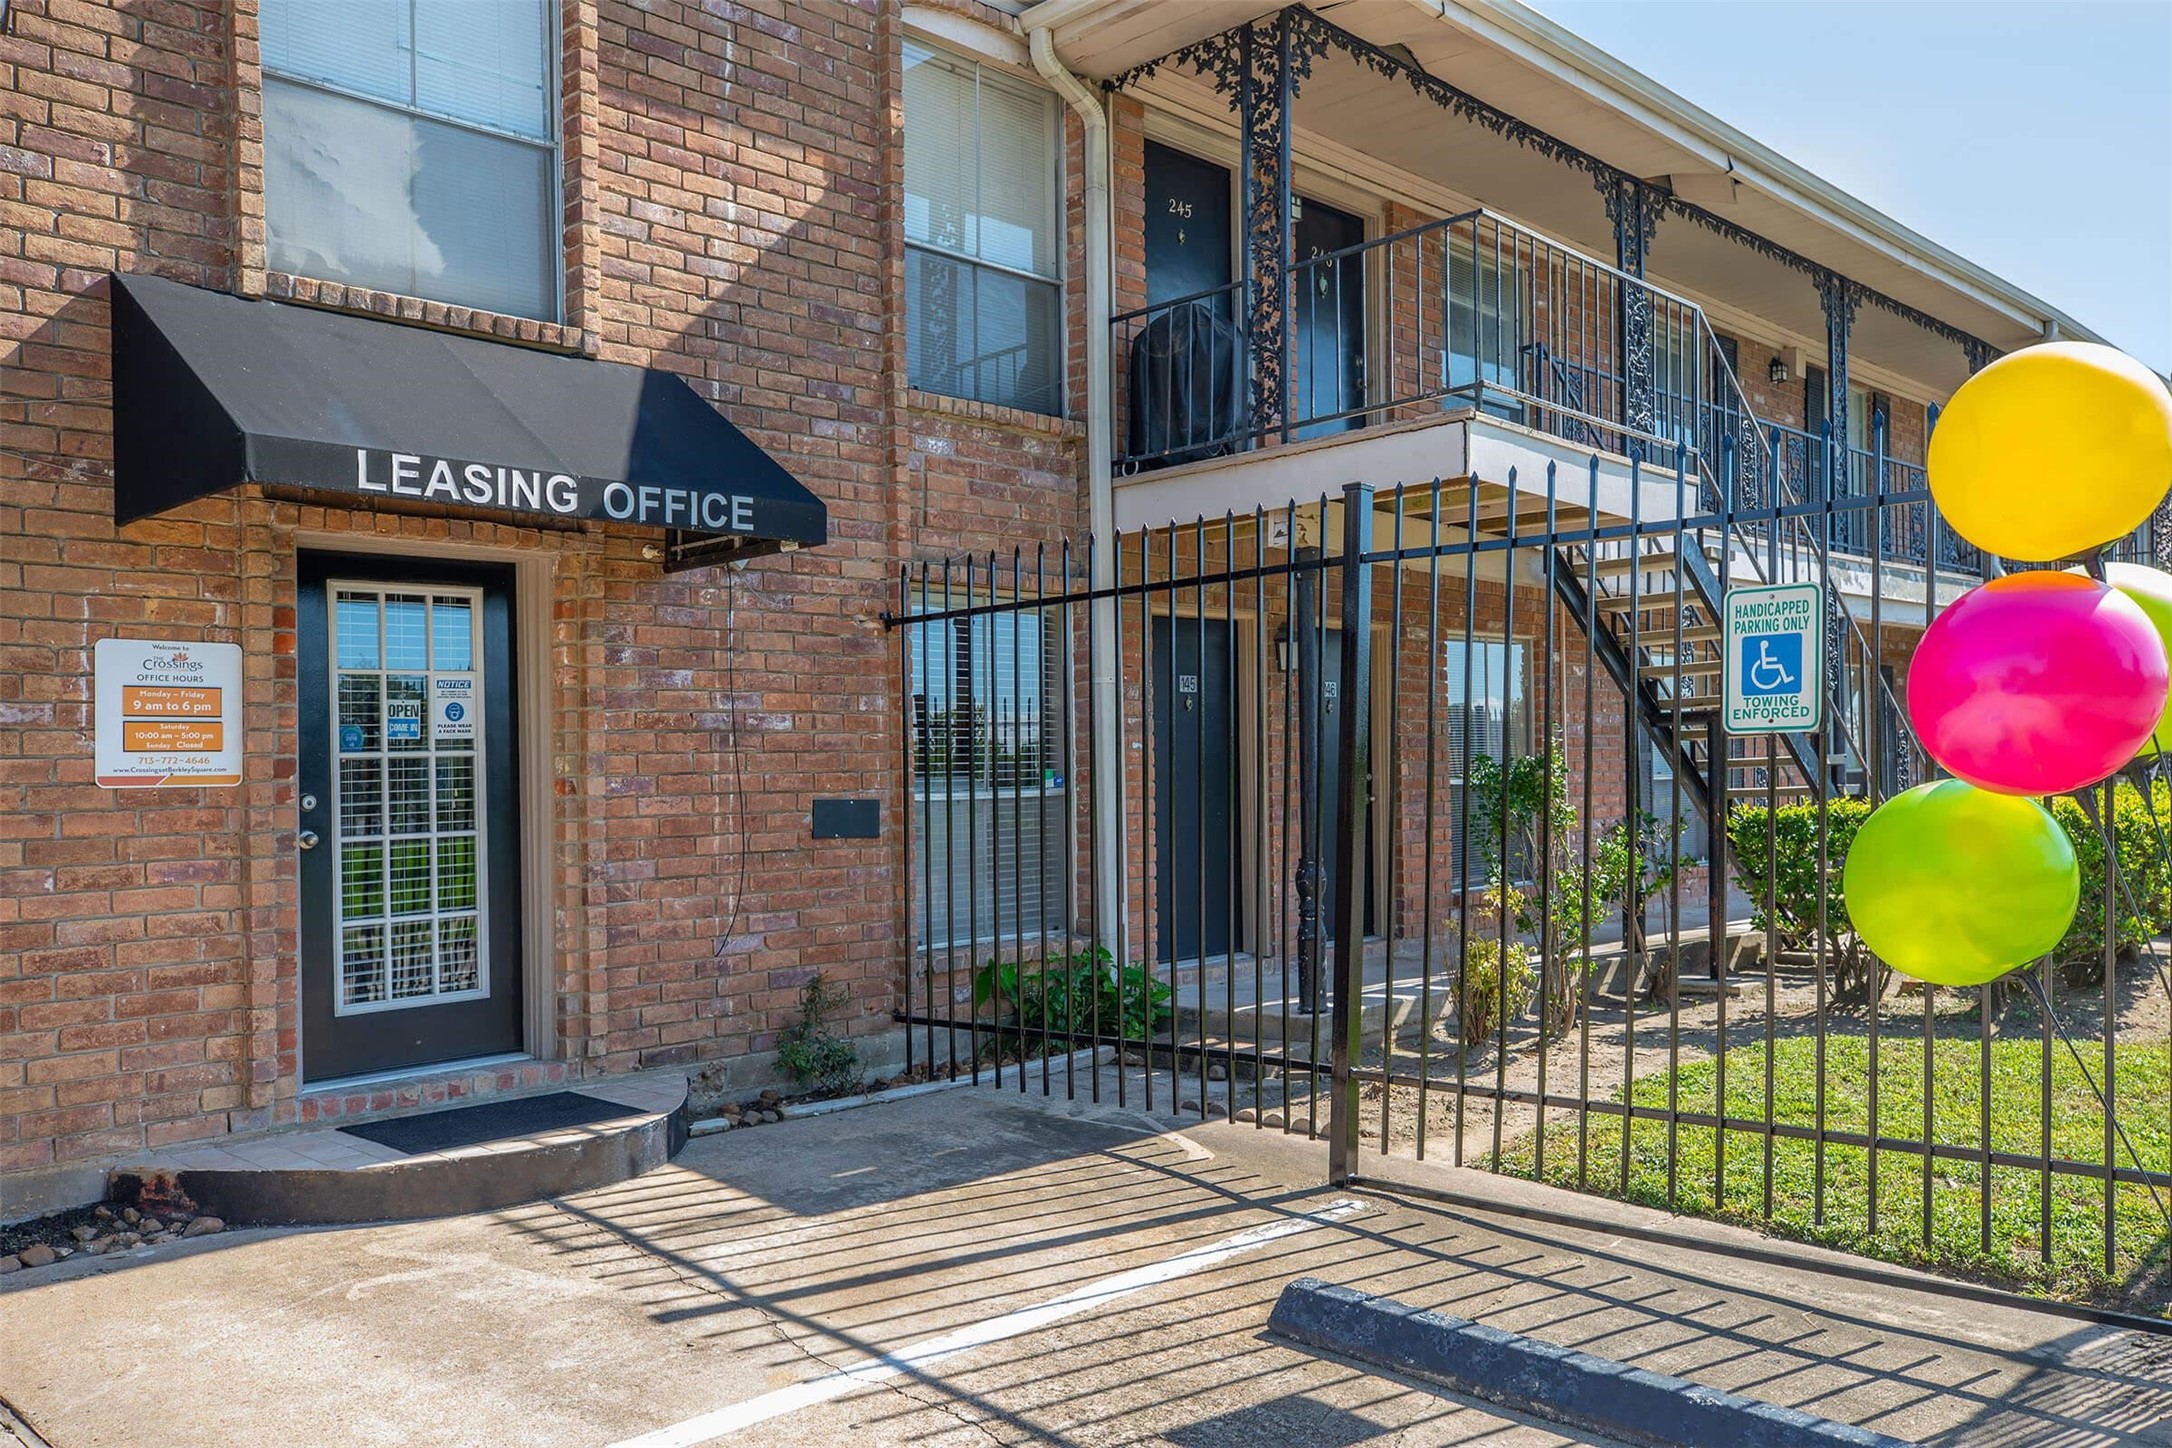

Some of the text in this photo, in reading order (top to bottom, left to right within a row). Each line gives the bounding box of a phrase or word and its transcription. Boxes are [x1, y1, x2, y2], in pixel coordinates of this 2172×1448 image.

[1168, 198, 1192, 218] 245
[357, 449, 754, 531] LEASING OFFICE
[1735, 599, 1810, 619] HANDICAPPED
[1734, 616, 1810, 634] PARKING ONLY
[152, 643, 181, 651] Welcome
[143, 659, 204, 672] Crossings
[137, 674, 204, 683] OFFICE HOURS
[1180, 676, 1196, 691] 145
[140, 690, 171, 699] Monday
[181, 690, 206, 700] Friday
[1743, 695, 1799, 708] TOWING
[133, 700, 211, 714] 9 am to 6 pm
[388, 704, 419, 718] OPEN
[1733, 706, 1810, 720] ENFORCED
[160, 723, 190, 731] Saturday
[389, 723, 418, 732] COME IN
[135, 732, 160, 740] 10:00
[181, 732, 200, 740] 5:00
[202, 733, 214, 741] pm
[146, 741, 204, 750] Sunday Closed
[138, 757, 211, 765] 713-772-4646
